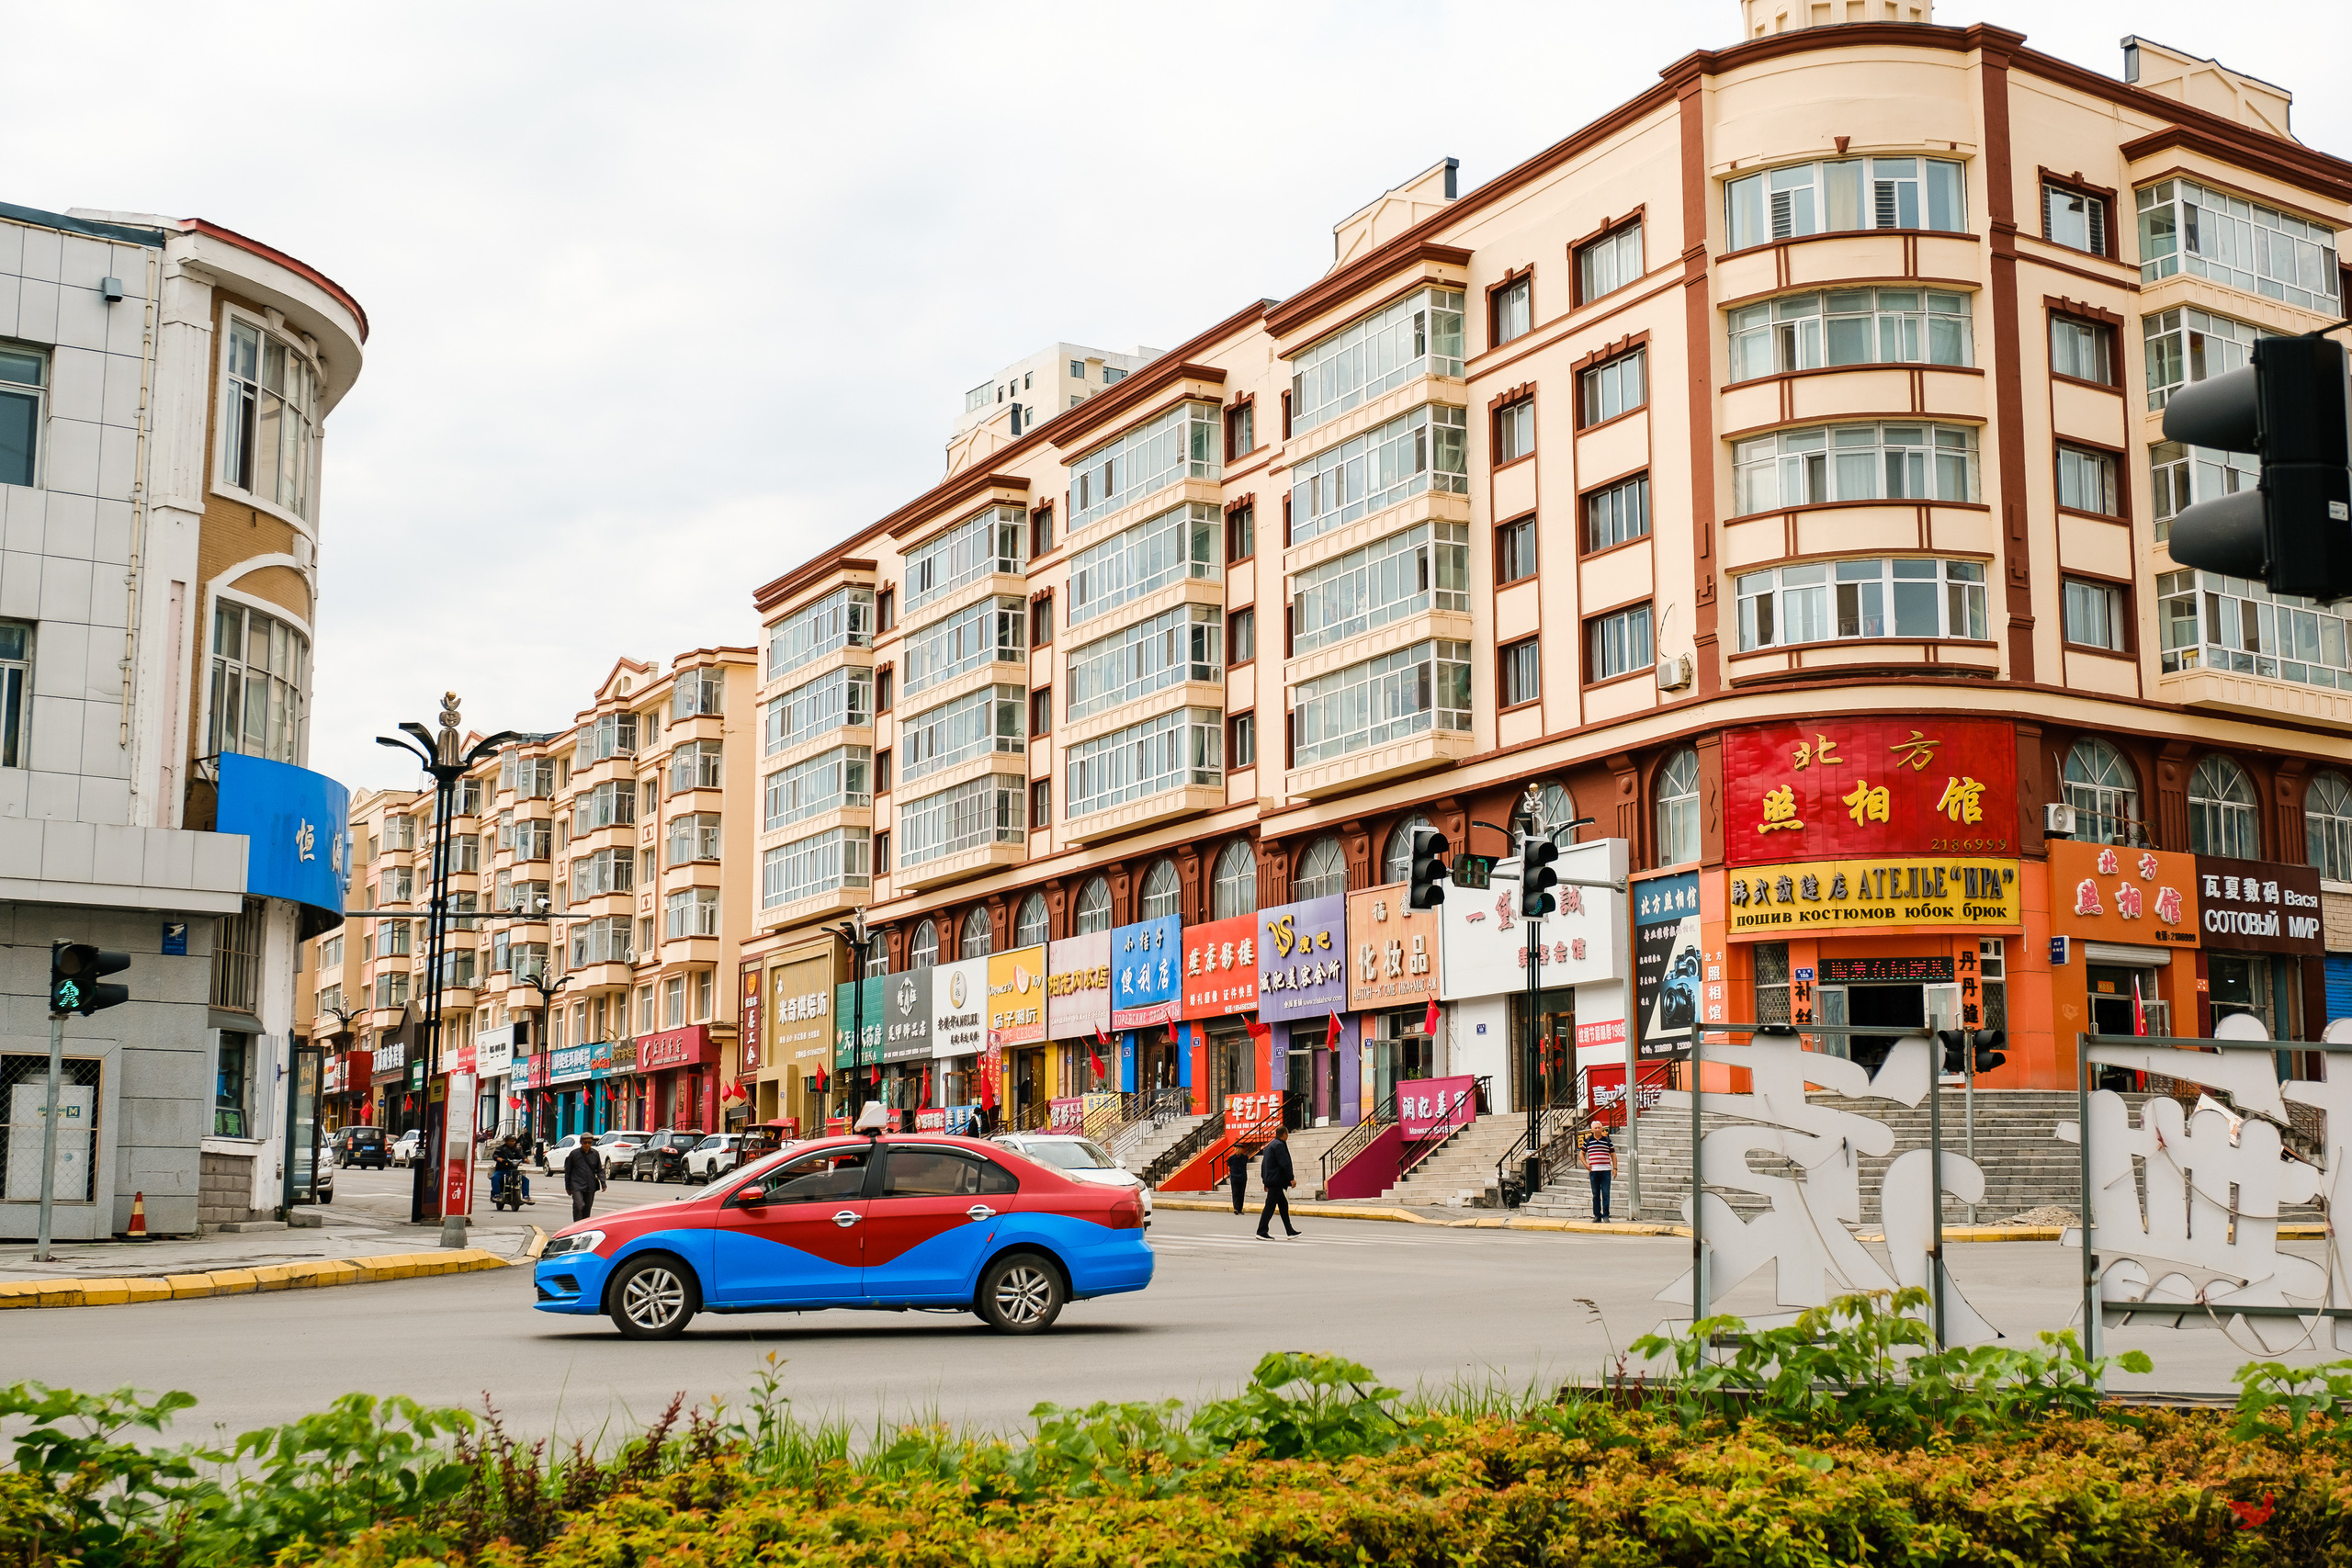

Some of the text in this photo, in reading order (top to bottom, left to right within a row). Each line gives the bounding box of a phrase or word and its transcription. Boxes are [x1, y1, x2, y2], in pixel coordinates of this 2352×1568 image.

[1792, 730, 1941, 771] 北方
[1758, 776, 1986, 834] 照相馆
[1931, 838, 2007, 852] 2186999
[1858, 866, 1948, 899] АТЕЛЬЕ
[2098, 849, 2158, 881] 北方
[1731, 872, 1849, 908] 韩式裁缝店
[2074, 878, 2182, 925] 照相馆
[2202, 874, 2318, 908] 瓦夏数码 Вася
[1736, 903, 2007, 927] пошив костюмов юбок брюк
[2205, 909, 2320, 940] СОТОВЫЙ МИР
[1358, 934, 1430, 982] 化妆品
[1121, 958, 1169, 995] 便利店
[1707, 965, 1722, 1021] 照相馆
[1232, 1093, 1280, 1122] 华艺广告
